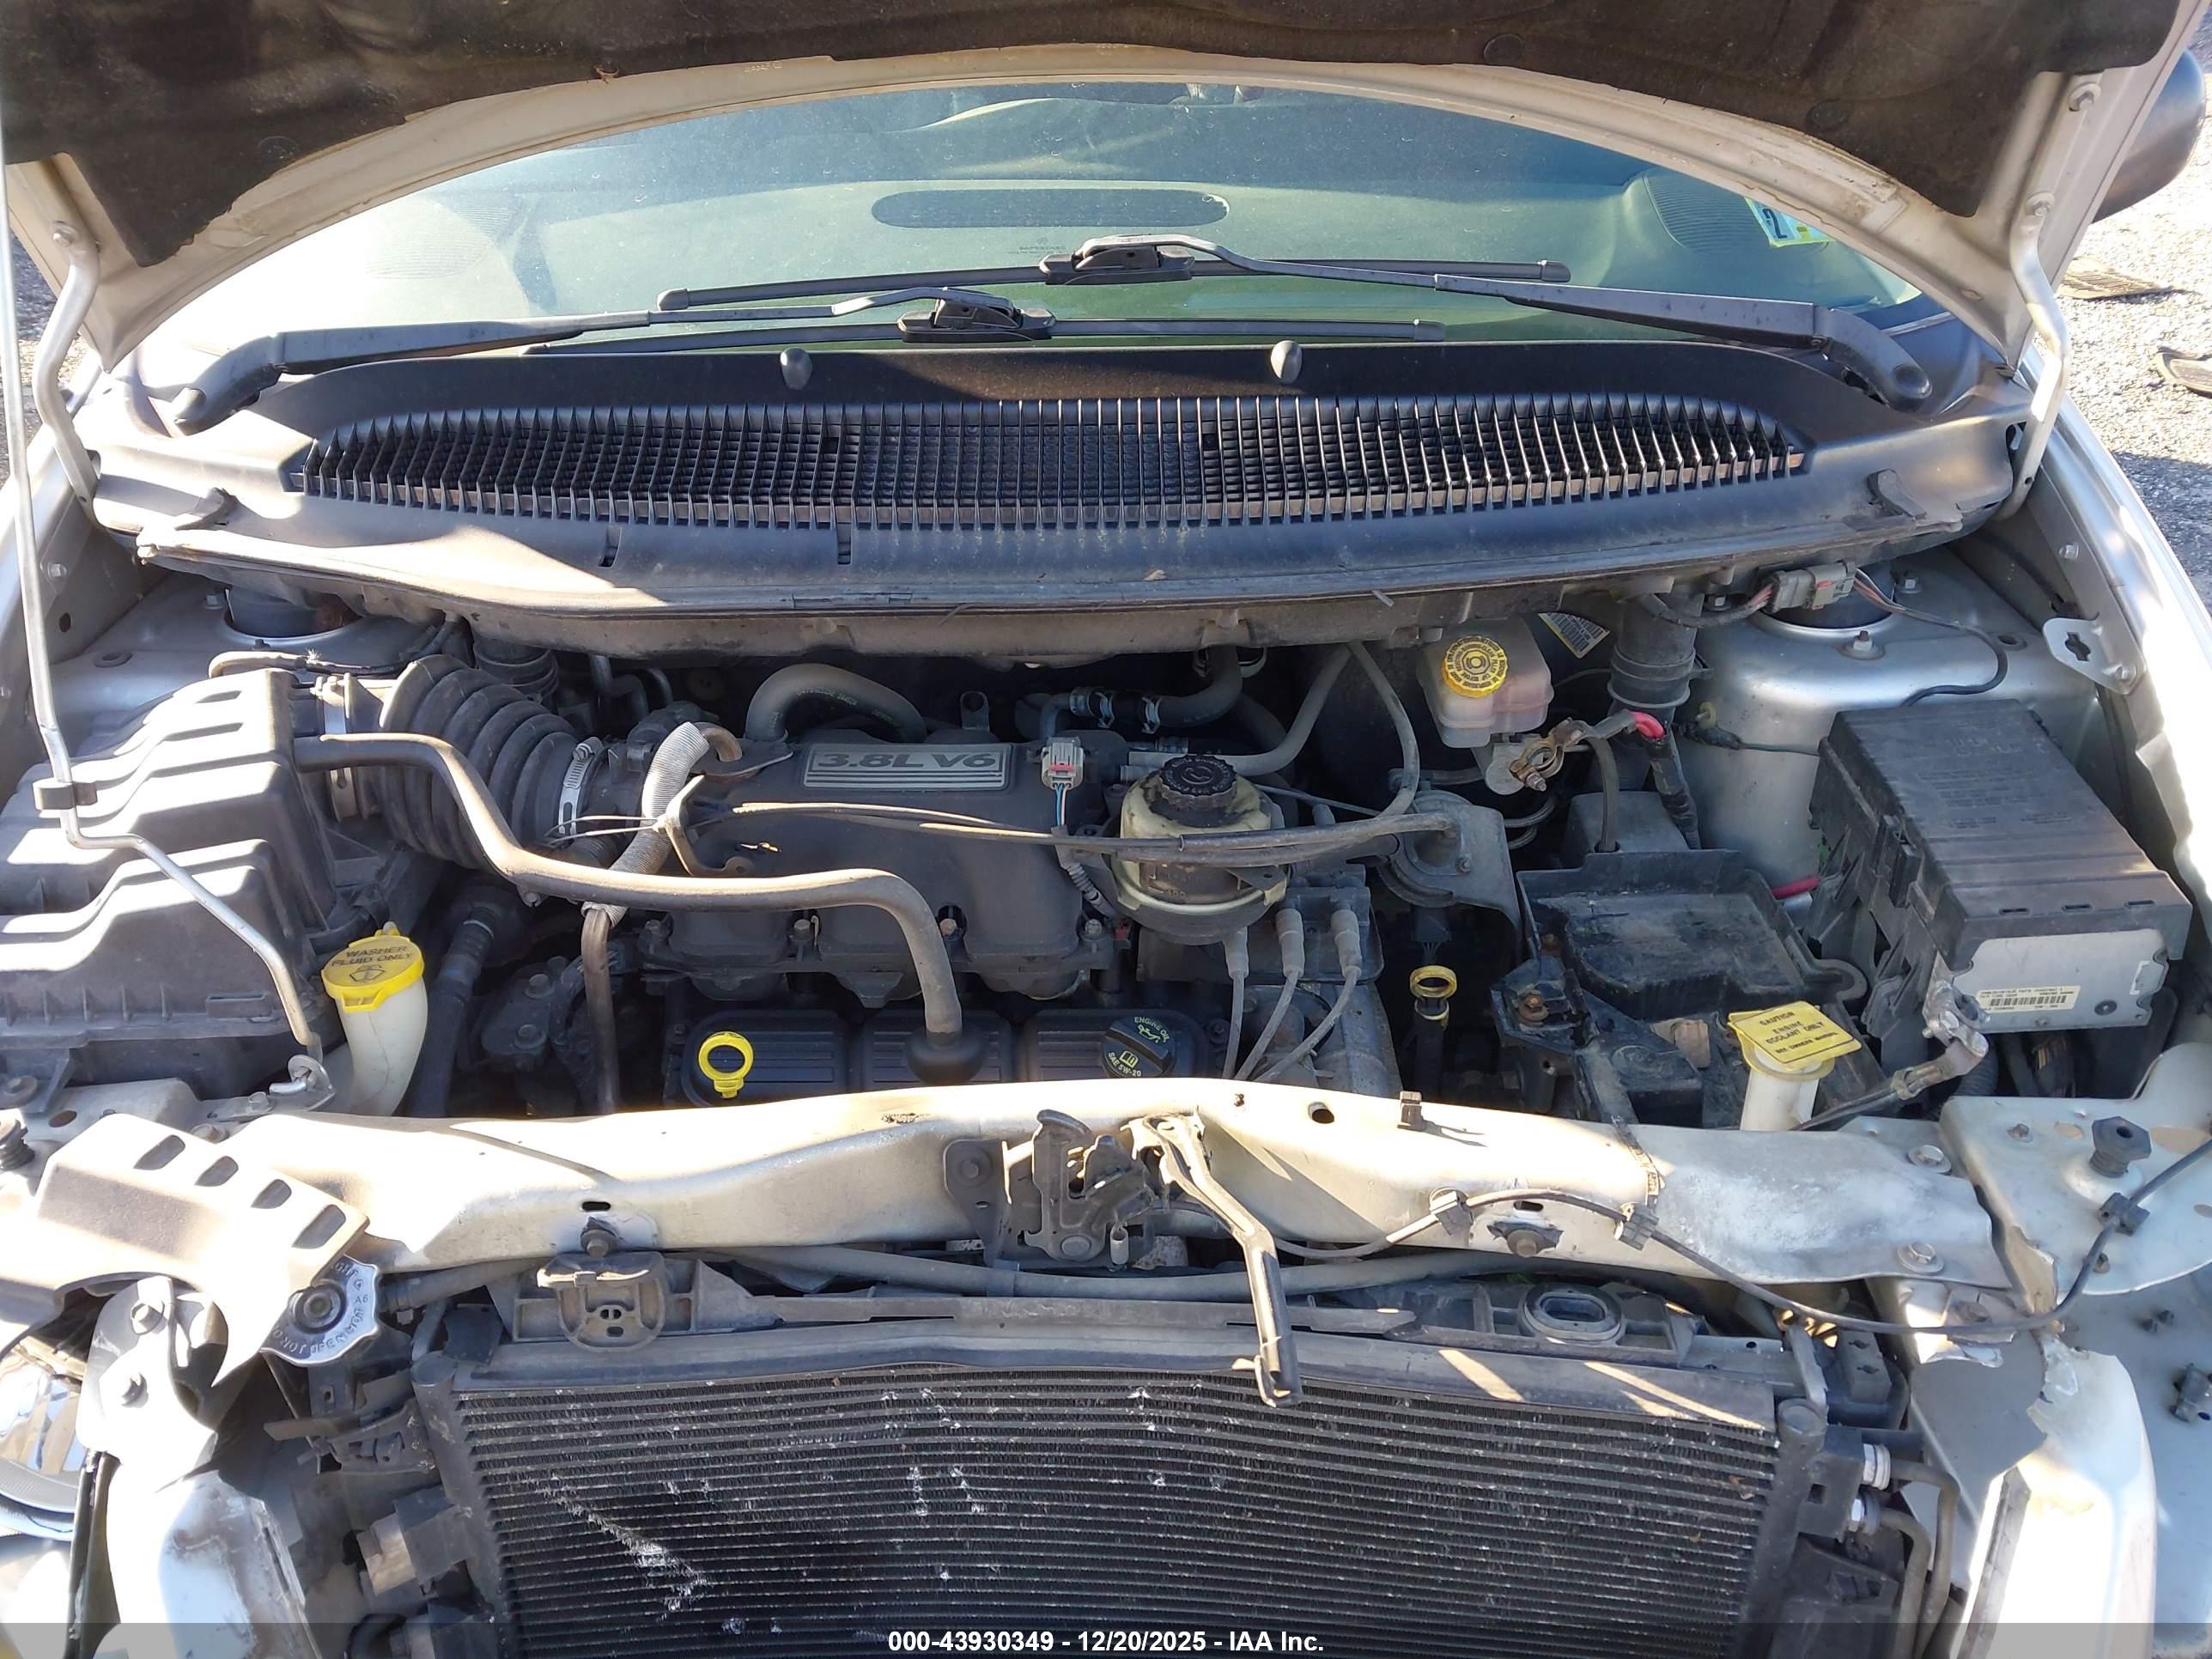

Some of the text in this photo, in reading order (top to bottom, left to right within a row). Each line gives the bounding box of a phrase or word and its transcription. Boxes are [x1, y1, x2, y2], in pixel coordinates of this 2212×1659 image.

[817, 753, 996, 768] 3.8L V6
[346, 945, 408, 957] WASHER
[331, 953, 412, 967] FLUID ONLY
[1759, 1012, 1796, 1025] CAUTION
[1133, 1016, 1170, 1043] ENGINE OIL
[1765, 1022, 1824, 1044] COOLANT ONLY
[1772, 1021, 1804, 1034] ENGINE
[1108, 1052, 1142, 1077] SAE 5W-20
